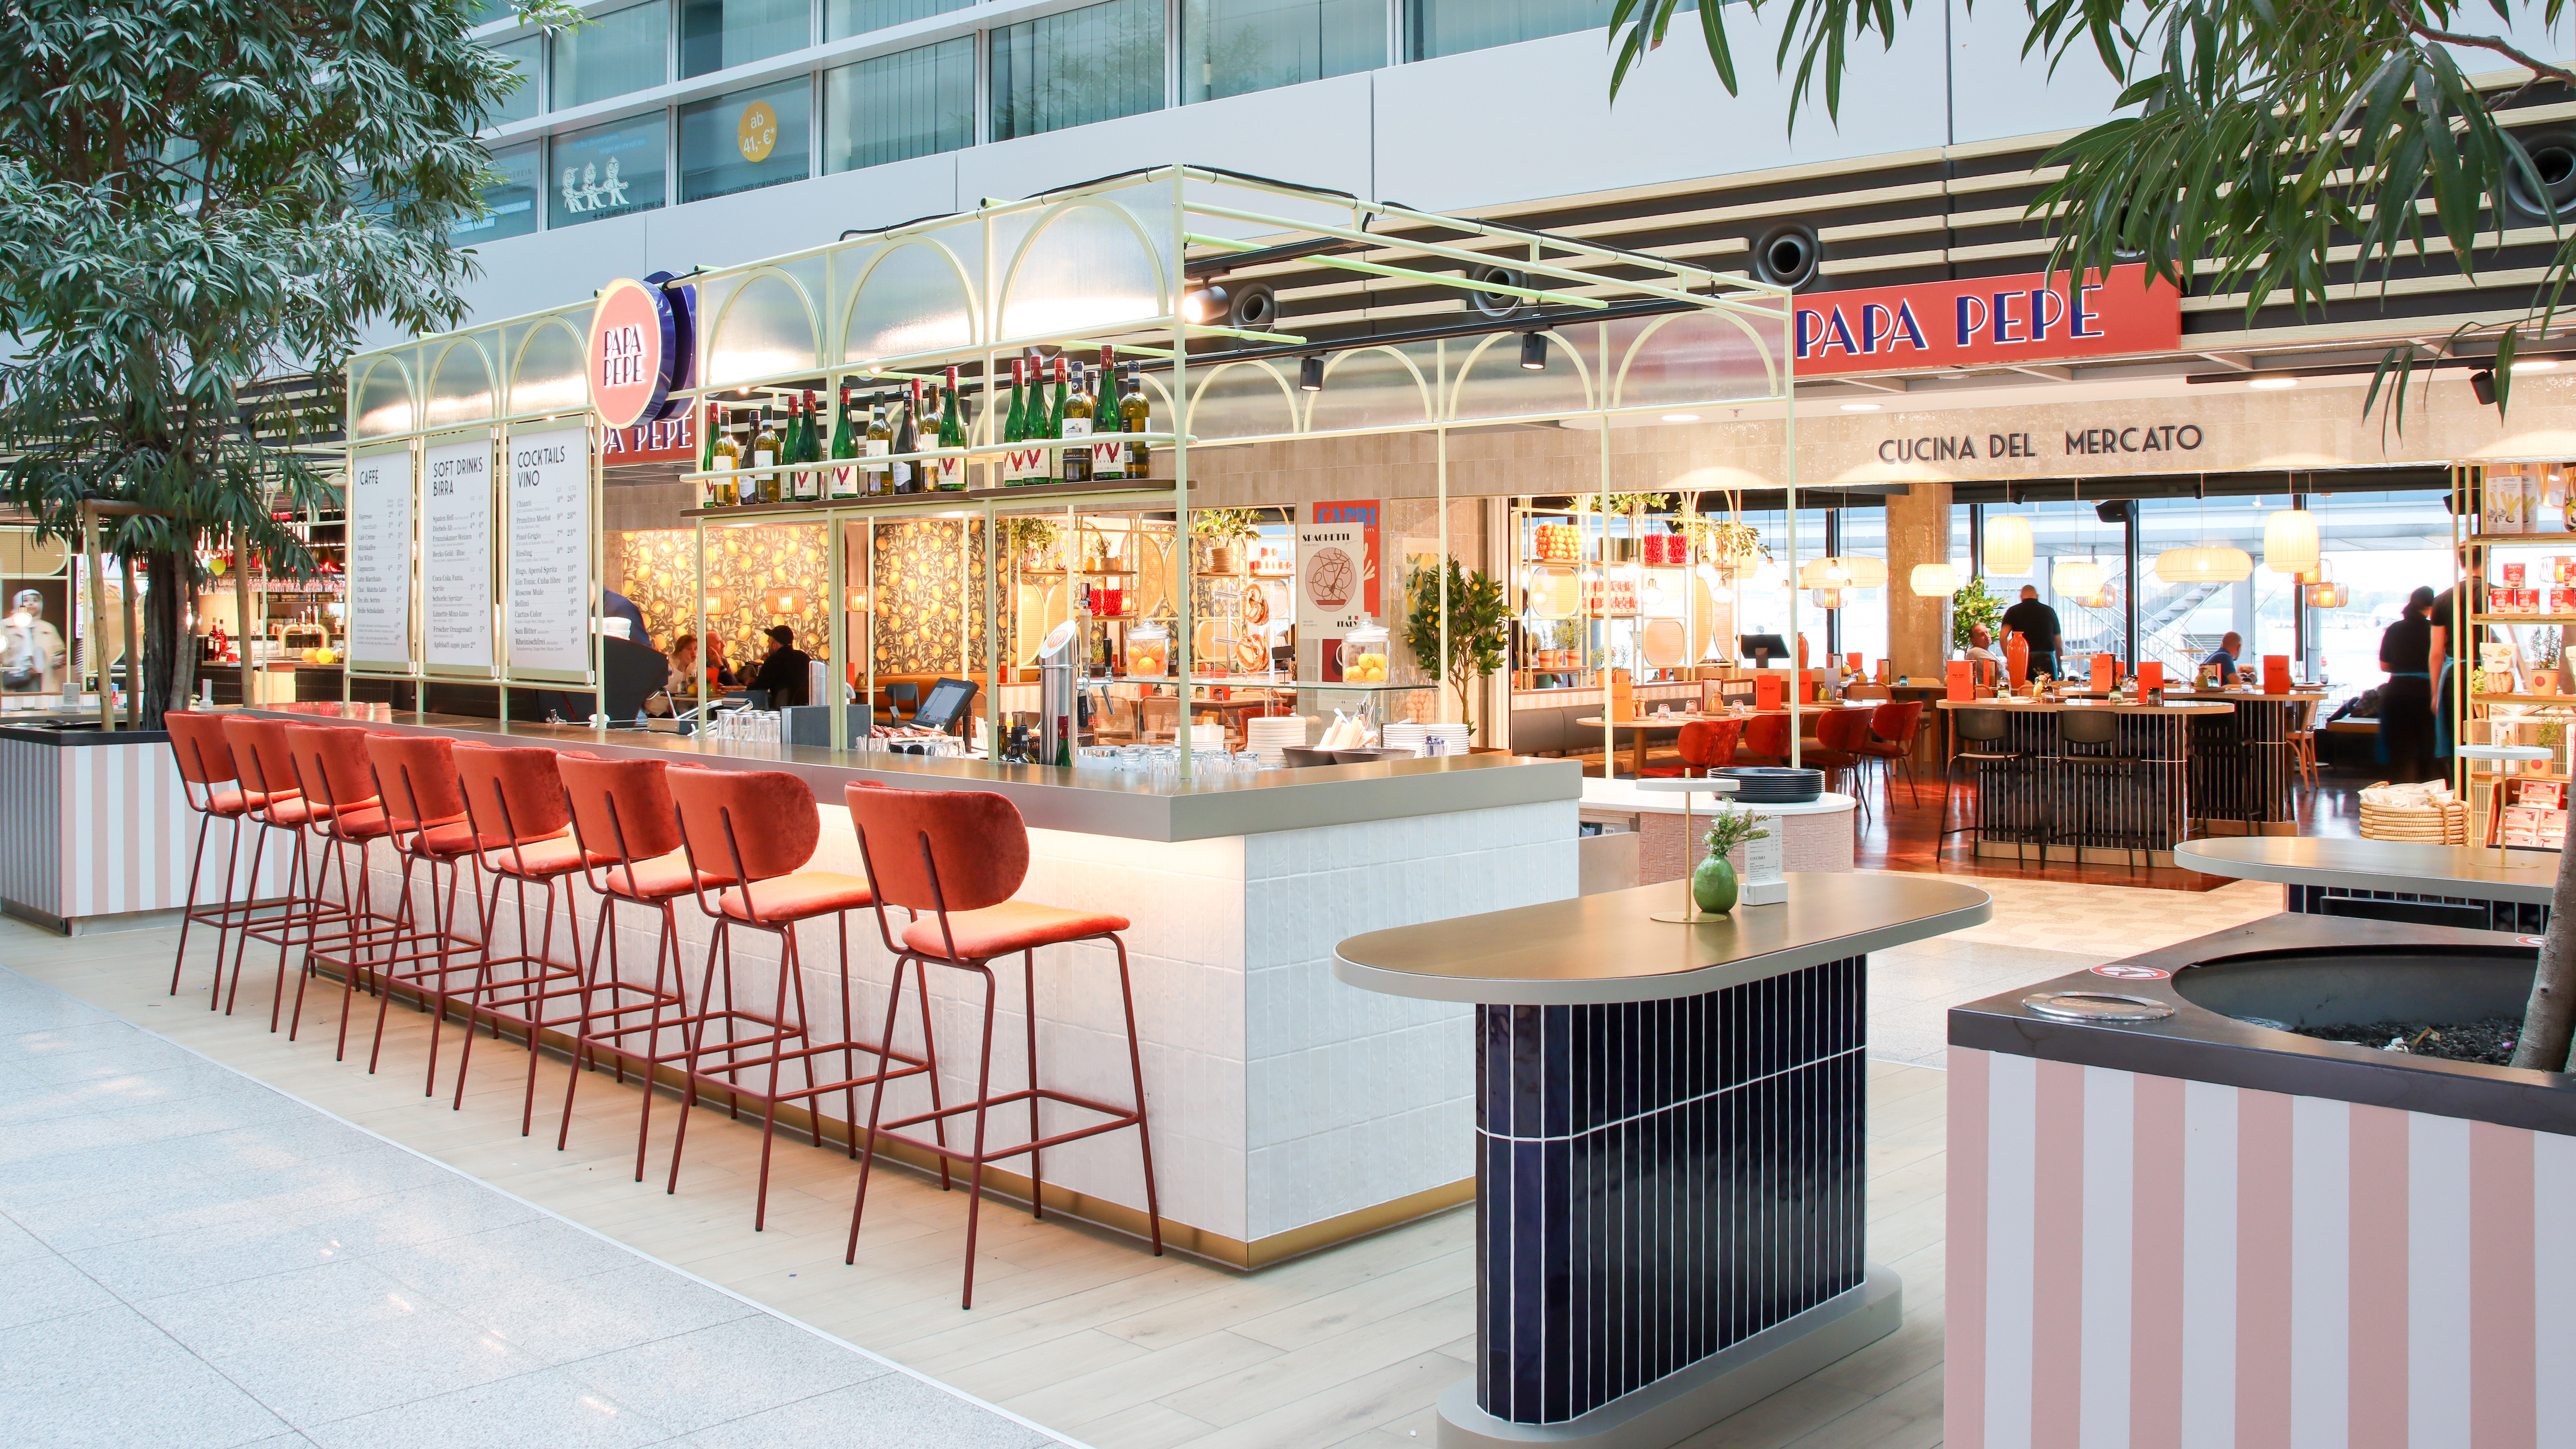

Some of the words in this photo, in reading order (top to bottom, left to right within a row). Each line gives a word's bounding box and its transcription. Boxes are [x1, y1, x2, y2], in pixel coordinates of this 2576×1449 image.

[751, 111, 764, 129] ab
[727, 183, 754, 195] GEGENÜBER
[754, 181, 765, 190] VOM
[766, 175, 793, 188] FAHRSTUHL
[611, 208, 625, 216] METER
[642, 202, 655, 210] EBENE
[1796, 297, 1929, 359] PAPA
[1956, 284, 2104, 347] PEPE
[604, 323, 645, 358] PAPA
[603, 354, 645, 388] PEPE
[634, 414, 693, 452] PEPE
[1879, 435, 1978, 464] CUCINA
[1989, 432, 2037, 458] DEL
[2066, 424, 2203, 456] MERCATO
[518, 445, 565, 468] COCKTAILS
[360, 466, 379, 485] CAFFÈ
[434, 460, 454, 478] SOFT
[457, 456, 483, 475] DRINKS
[433, 479, 454, 496] BIRRA
[518, 470, 540, 488] VINO
[517, 499, 532, 508] Chianti
[433, 515, 446, 523] Spaten
[1318, 507, 1376, 525] CAPRI
[527, 531, 541, 540] Grigio
[1302, 533, 1350, 542] SPAGHETTI
[516, 567, 527, 576] Hugo,
[528, 566, 543, 576] Aperol
[543, 566, 557, 574] Spritz
[432, 585, 445, 594] Sprite
[450, 625, 473, 634] Orangensaft
